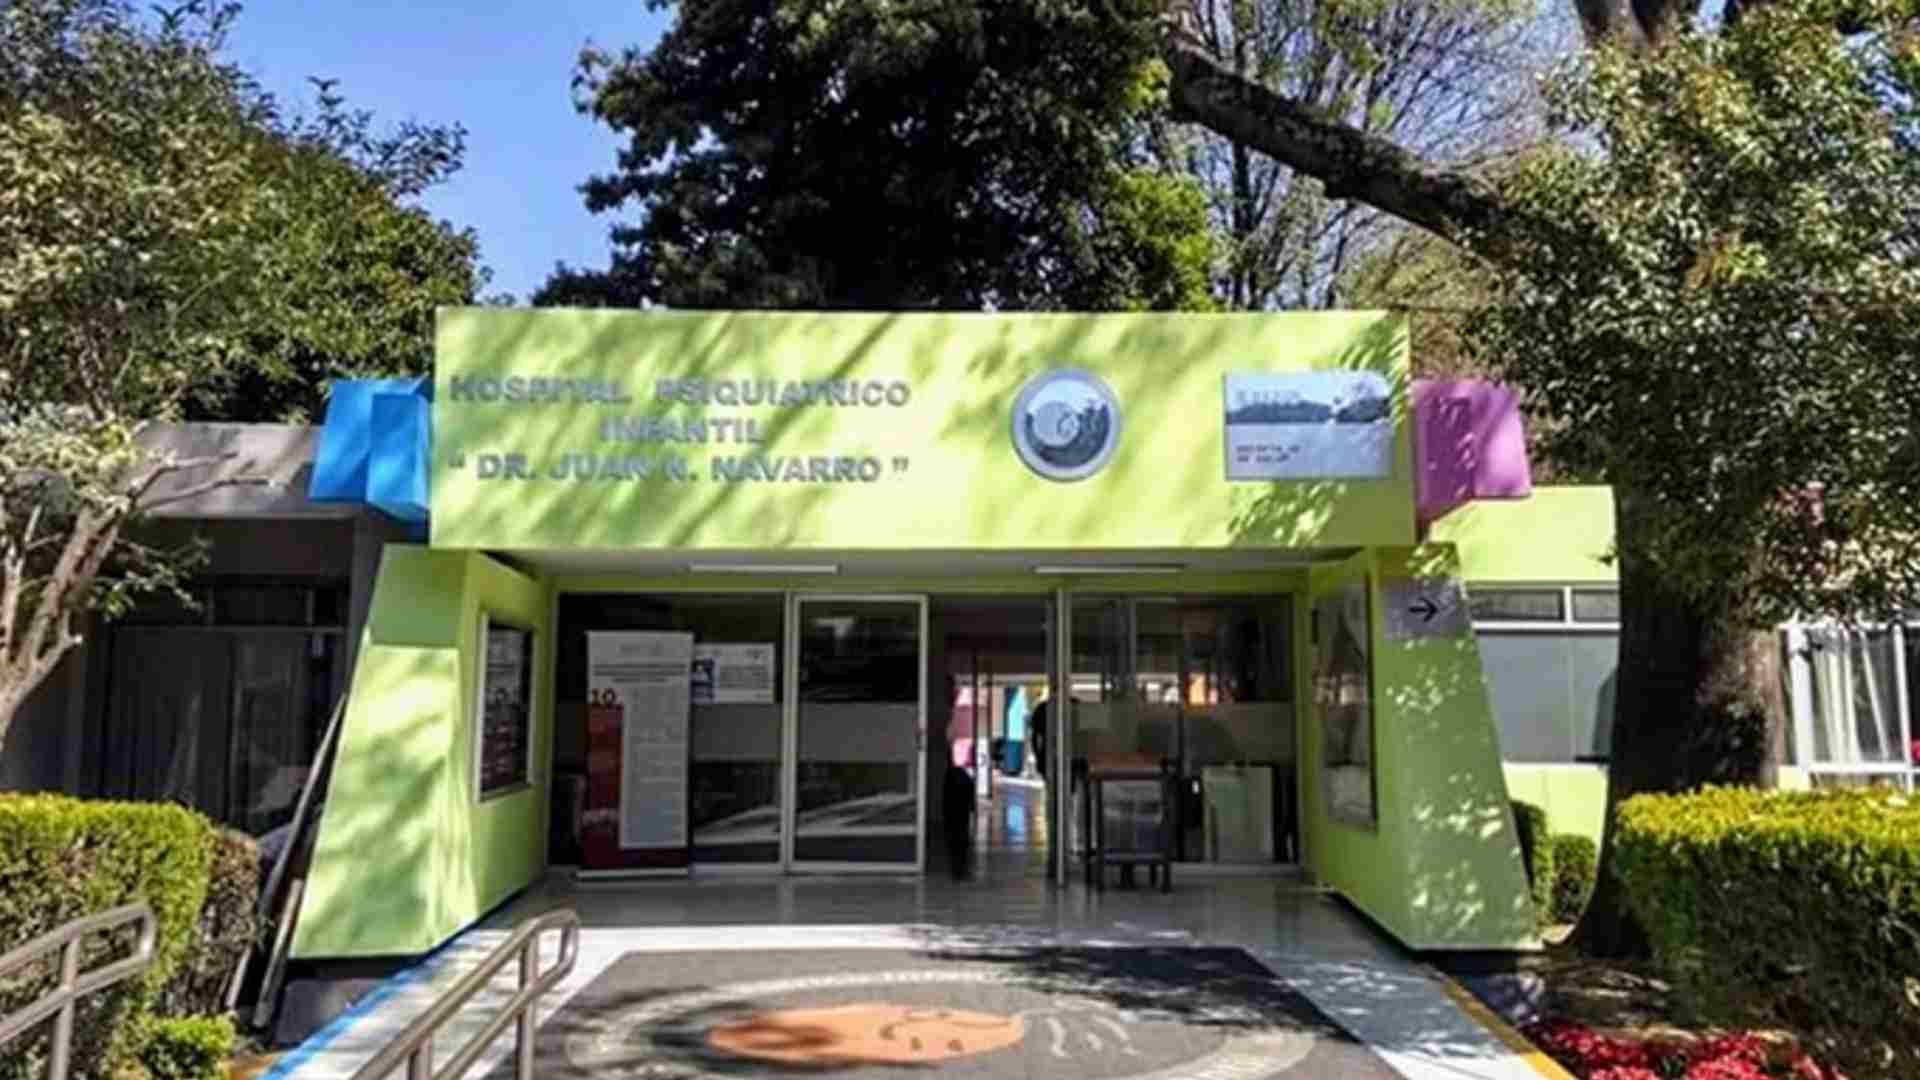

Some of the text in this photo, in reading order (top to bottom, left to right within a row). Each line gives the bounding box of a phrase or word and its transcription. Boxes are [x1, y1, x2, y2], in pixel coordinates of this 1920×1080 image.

[451, 376, 911, 408] HOSPITAL PSIQUIATRICO
[600, 417, 766, 446] INFANTIL
[478, 454, 537, 480] DR.
[551, 452, 650, 481] JUAN
[662, 454, 698, 482] N.
[711, 456, 880, 482] NAVARRO
